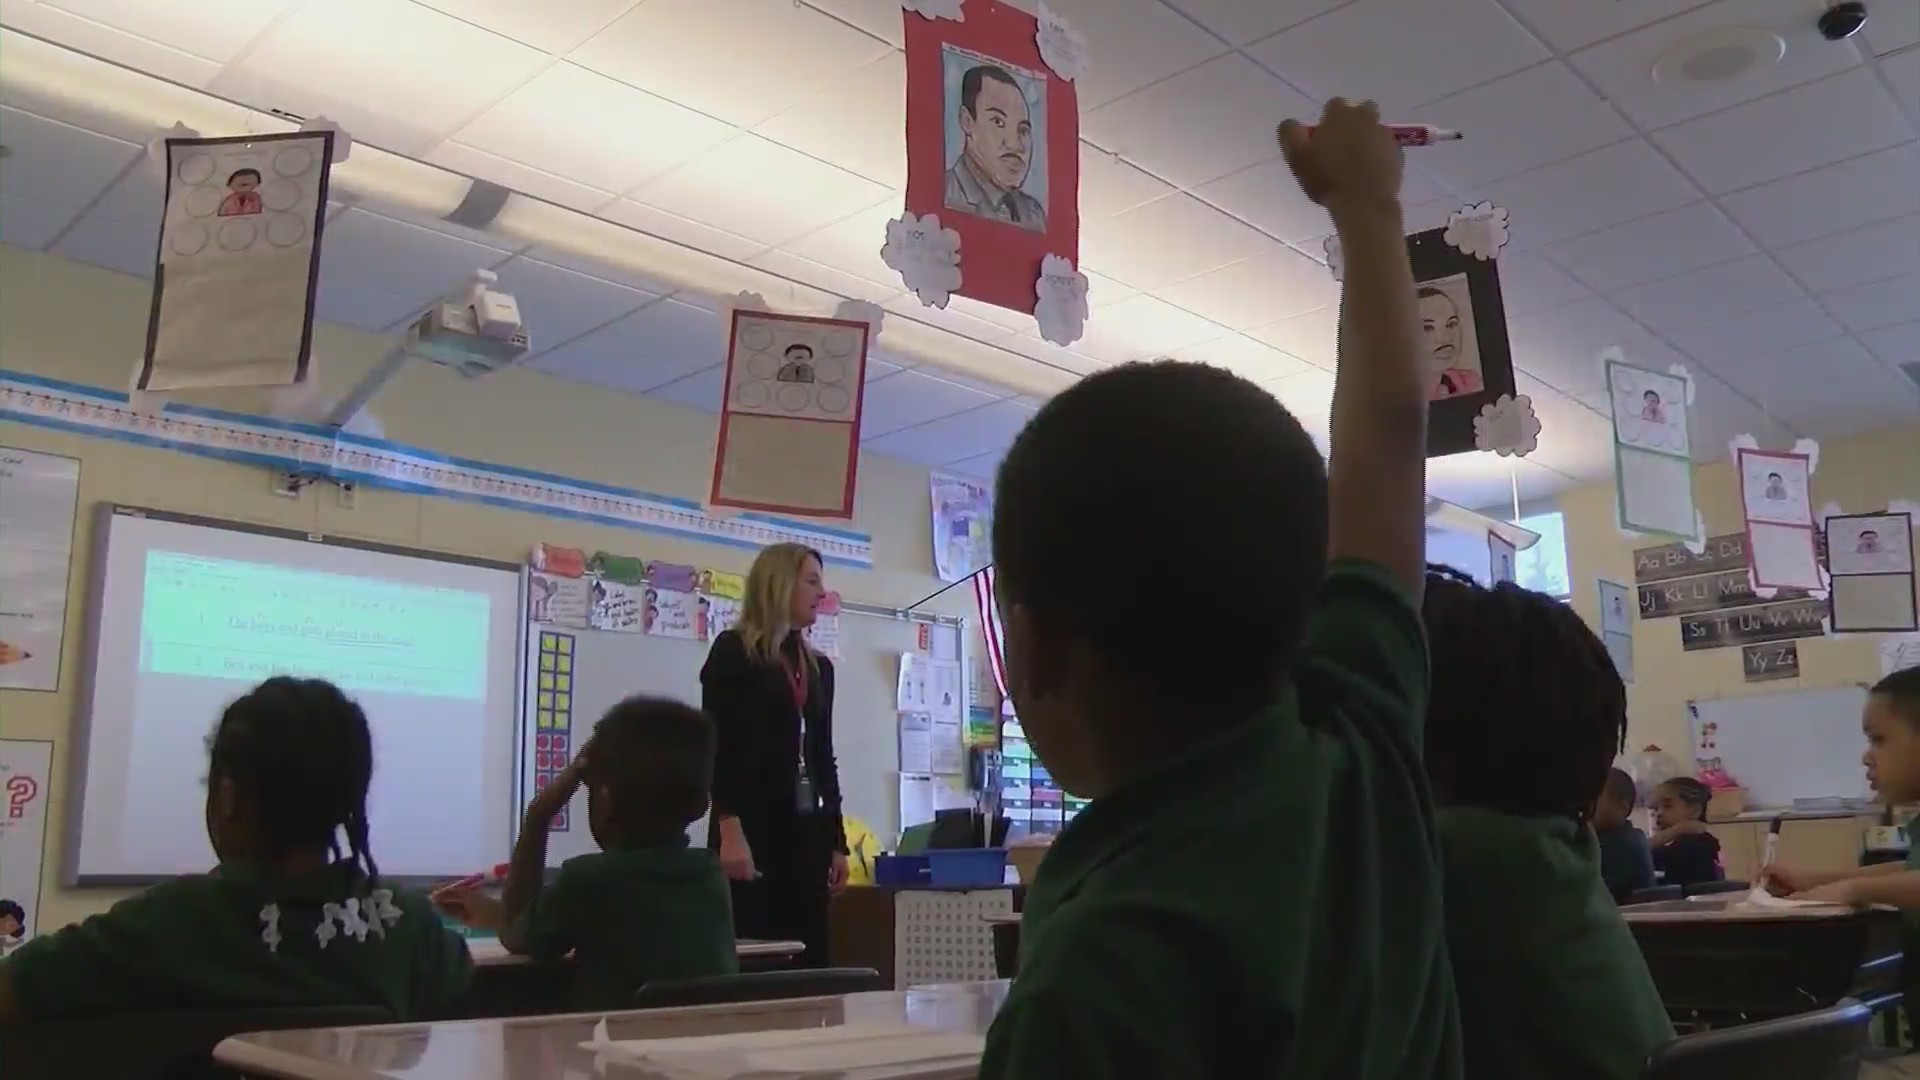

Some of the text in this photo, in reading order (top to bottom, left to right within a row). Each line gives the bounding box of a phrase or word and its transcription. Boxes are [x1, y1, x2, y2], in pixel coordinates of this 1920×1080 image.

[1637, 556, 1660, 570] Aa
[1665, 550, 1687, 566] Bb
[1720, 542, 1742, 557] Dd
[1640, 591, 1656, 611] Jj
[1664, 586, 1686, 602] Kk
[1693, 582, 1708, 598] Ll
[1690, 622, 1706, 637] Ss
[1716, 618, 1730, 633] Tt
[1739, 614, 1761, 631] Uu
[1768, 611, 1788, 626] Vv
[1750, 649, 1794, 673] Yy Zz
